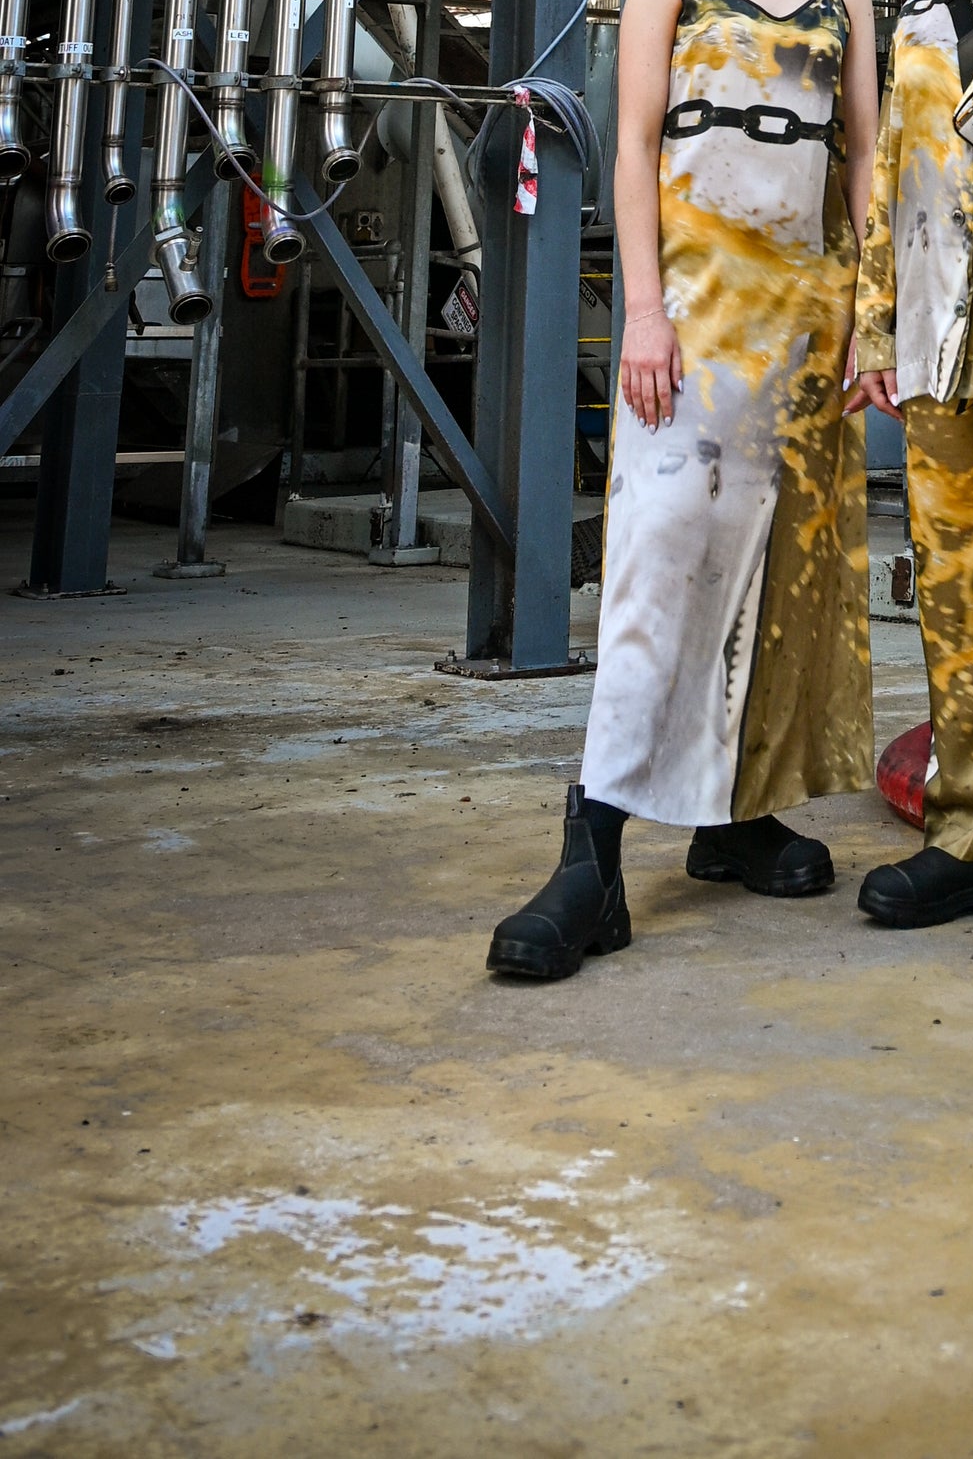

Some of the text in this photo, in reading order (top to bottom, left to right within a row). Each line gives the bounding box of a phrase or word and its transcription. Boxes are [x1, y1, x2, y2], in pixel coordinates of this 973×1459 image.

[174, 30, 192, 38] ASH
[452, 297, 472, 333] CONFINED
[460, 291, 476, 318] DANGER
